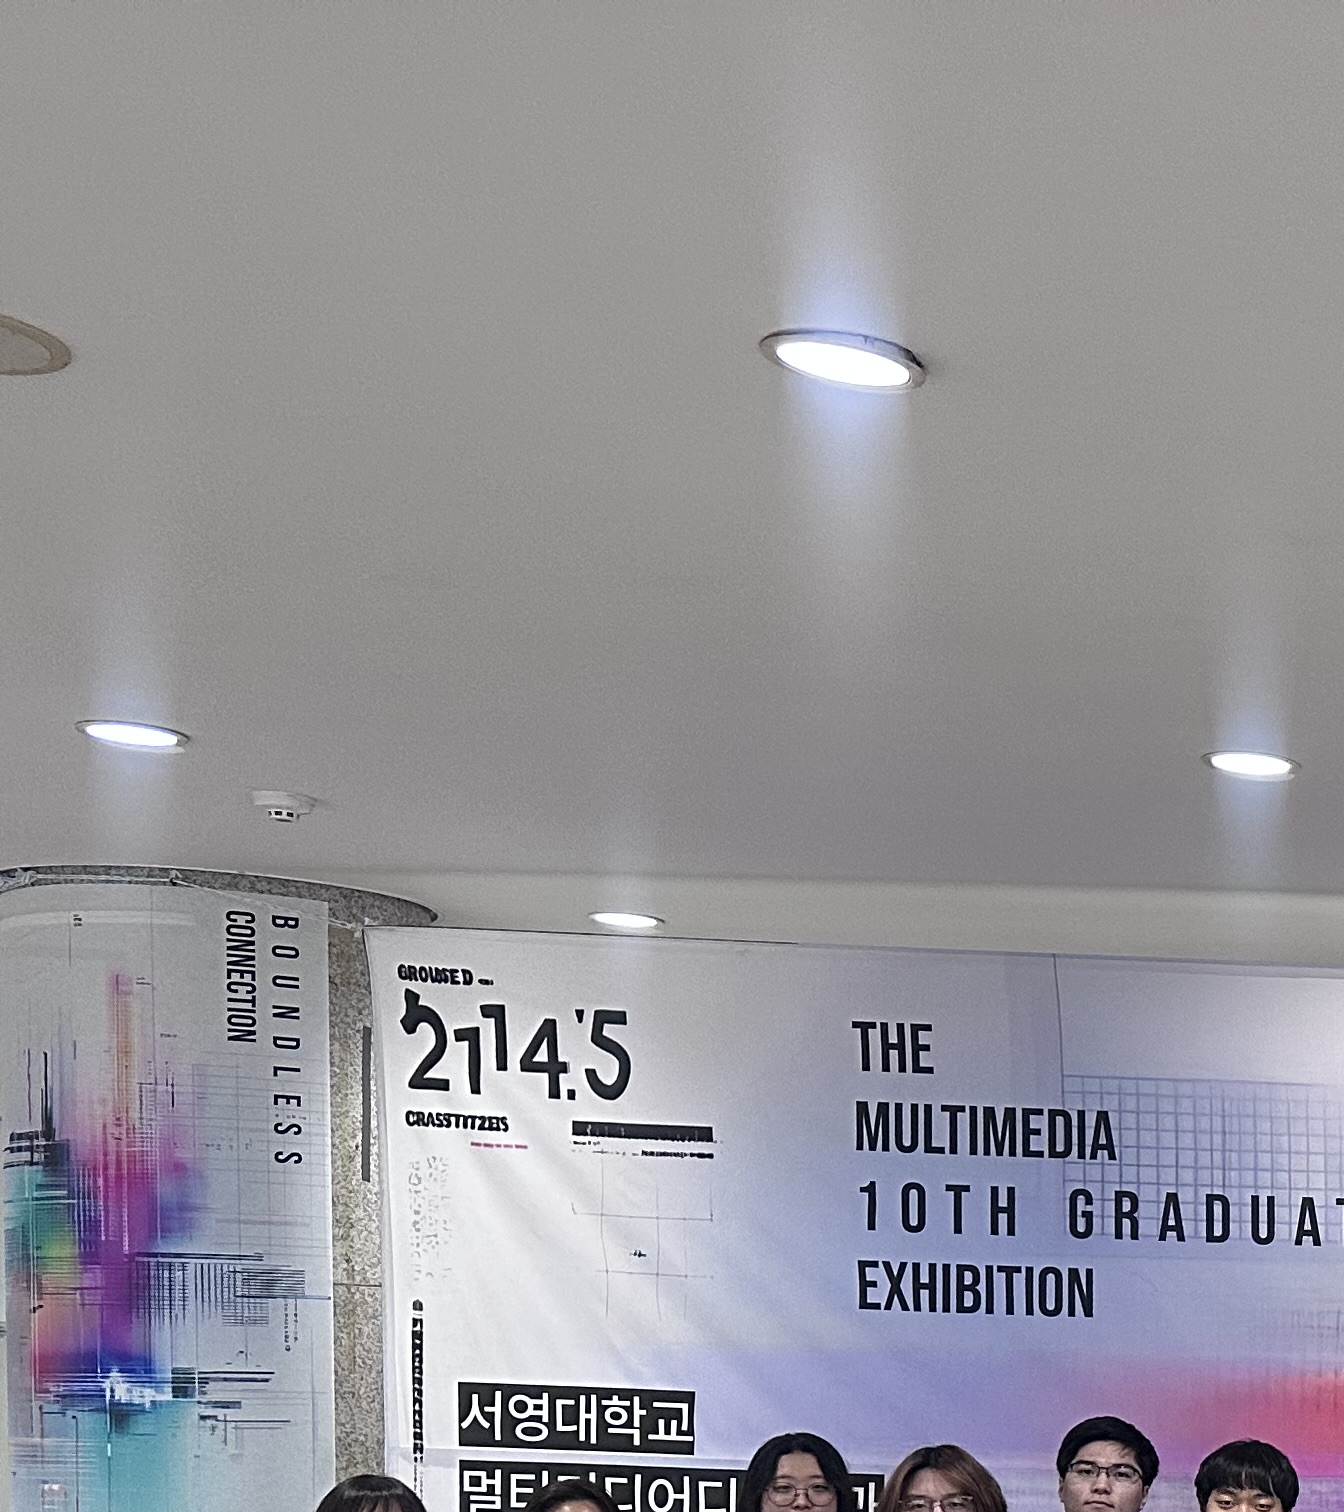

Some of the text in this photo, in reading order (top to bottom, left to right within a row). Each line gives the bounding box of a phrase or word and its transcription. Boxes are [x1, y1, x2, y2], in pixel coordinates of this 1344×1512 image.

[226, 910, 257, 1043] CONNECTION
[272, 914, 303, 1165] BOUNDLESS
[851, 1020, 935, 1075] THE
[855, 1100, 1118, 1161] MULTIMEDIA
[859, 1180, 1016, 1237] 10TH
[857, 1259, 1094, 1318] EXHIBITION
[460, 1390, 694, 1445] 서영대학교
